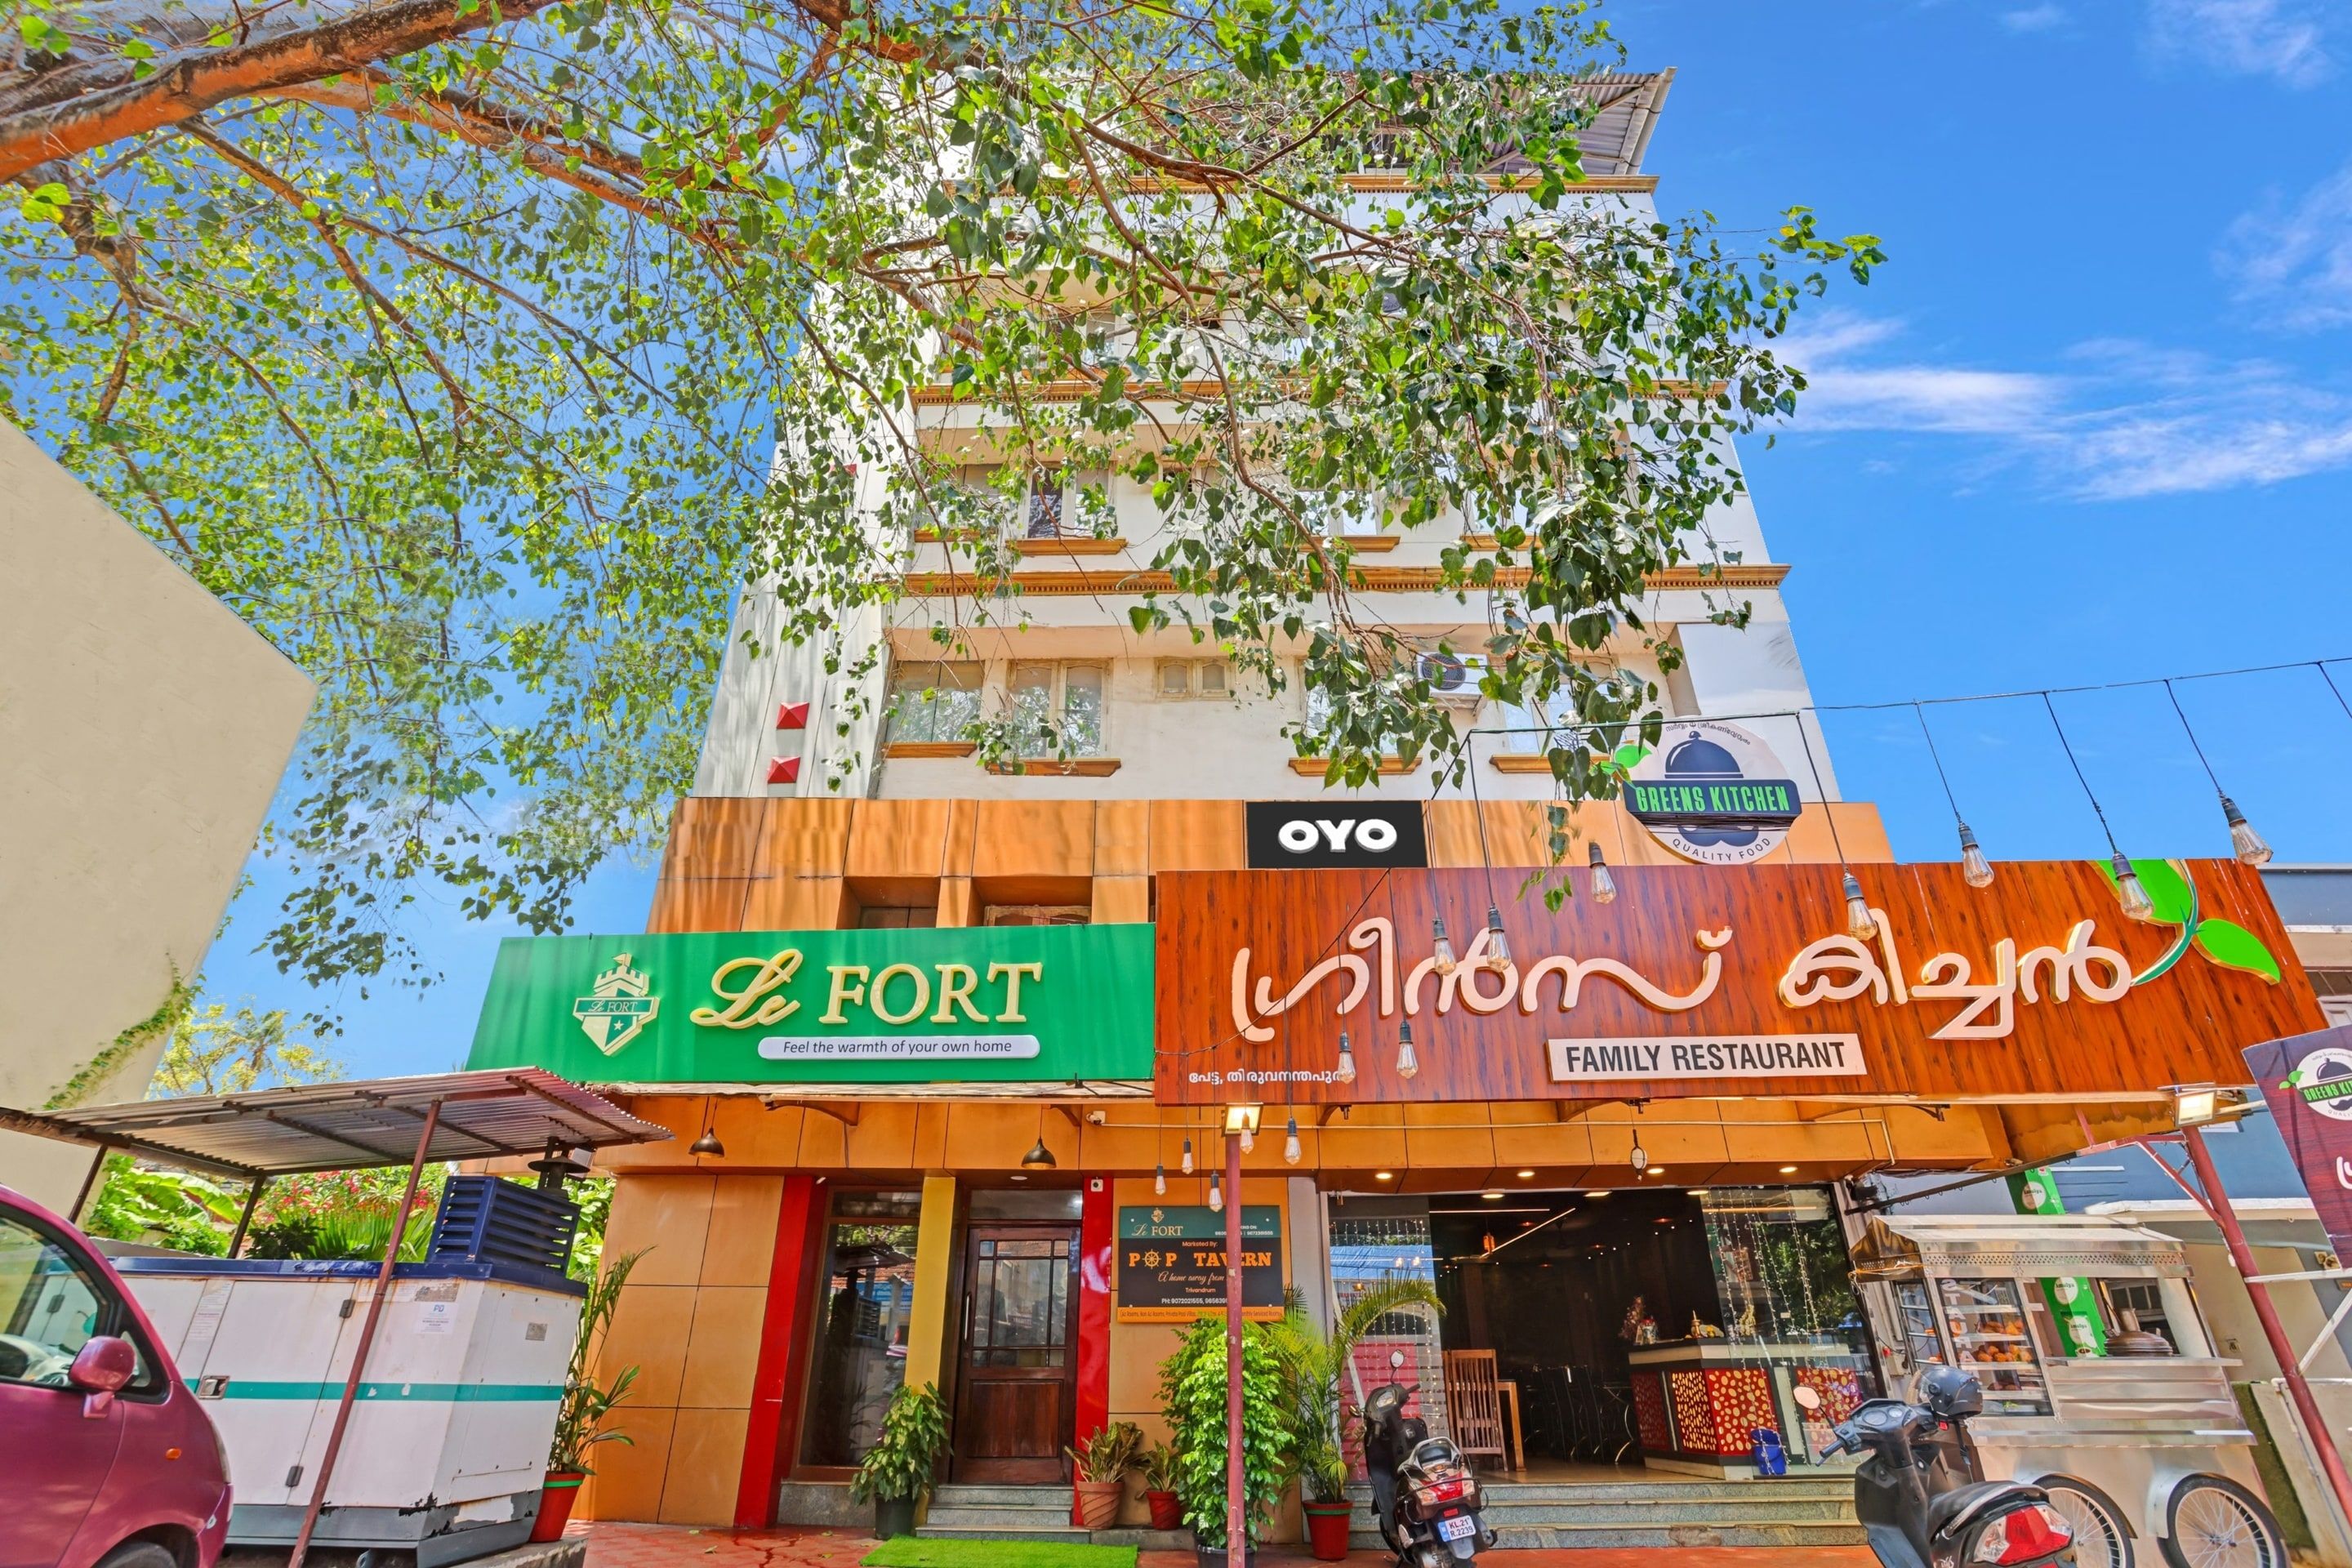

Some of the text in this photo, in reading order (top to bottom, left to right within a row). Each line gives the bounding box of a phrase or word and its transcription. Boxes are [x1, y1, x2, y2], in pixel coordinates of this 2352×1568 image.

[1636, 786, 1790, 813] GREENS KITCHEN
[1278, 818, 1397, 853] OYO
[1672, 837, 1771, 862] QUALITY FOOD
[1780, 908, 2132, 1040] കിച്ചൻ
[690, 948, 1043, 1030] Le FORT
[588, 1000, 639, 1013] Le FORT
[783, 1040, 1012, 1055] Feel the warmth of your own home
[1567, 1040, 1846, 1073] FAMILY RESTAURANT
[2304, 1084, 2340, 1101] GREENS
[1152, 1226, 1183, 1236] FORT
[1158, 1271, 1169, 1282] A
